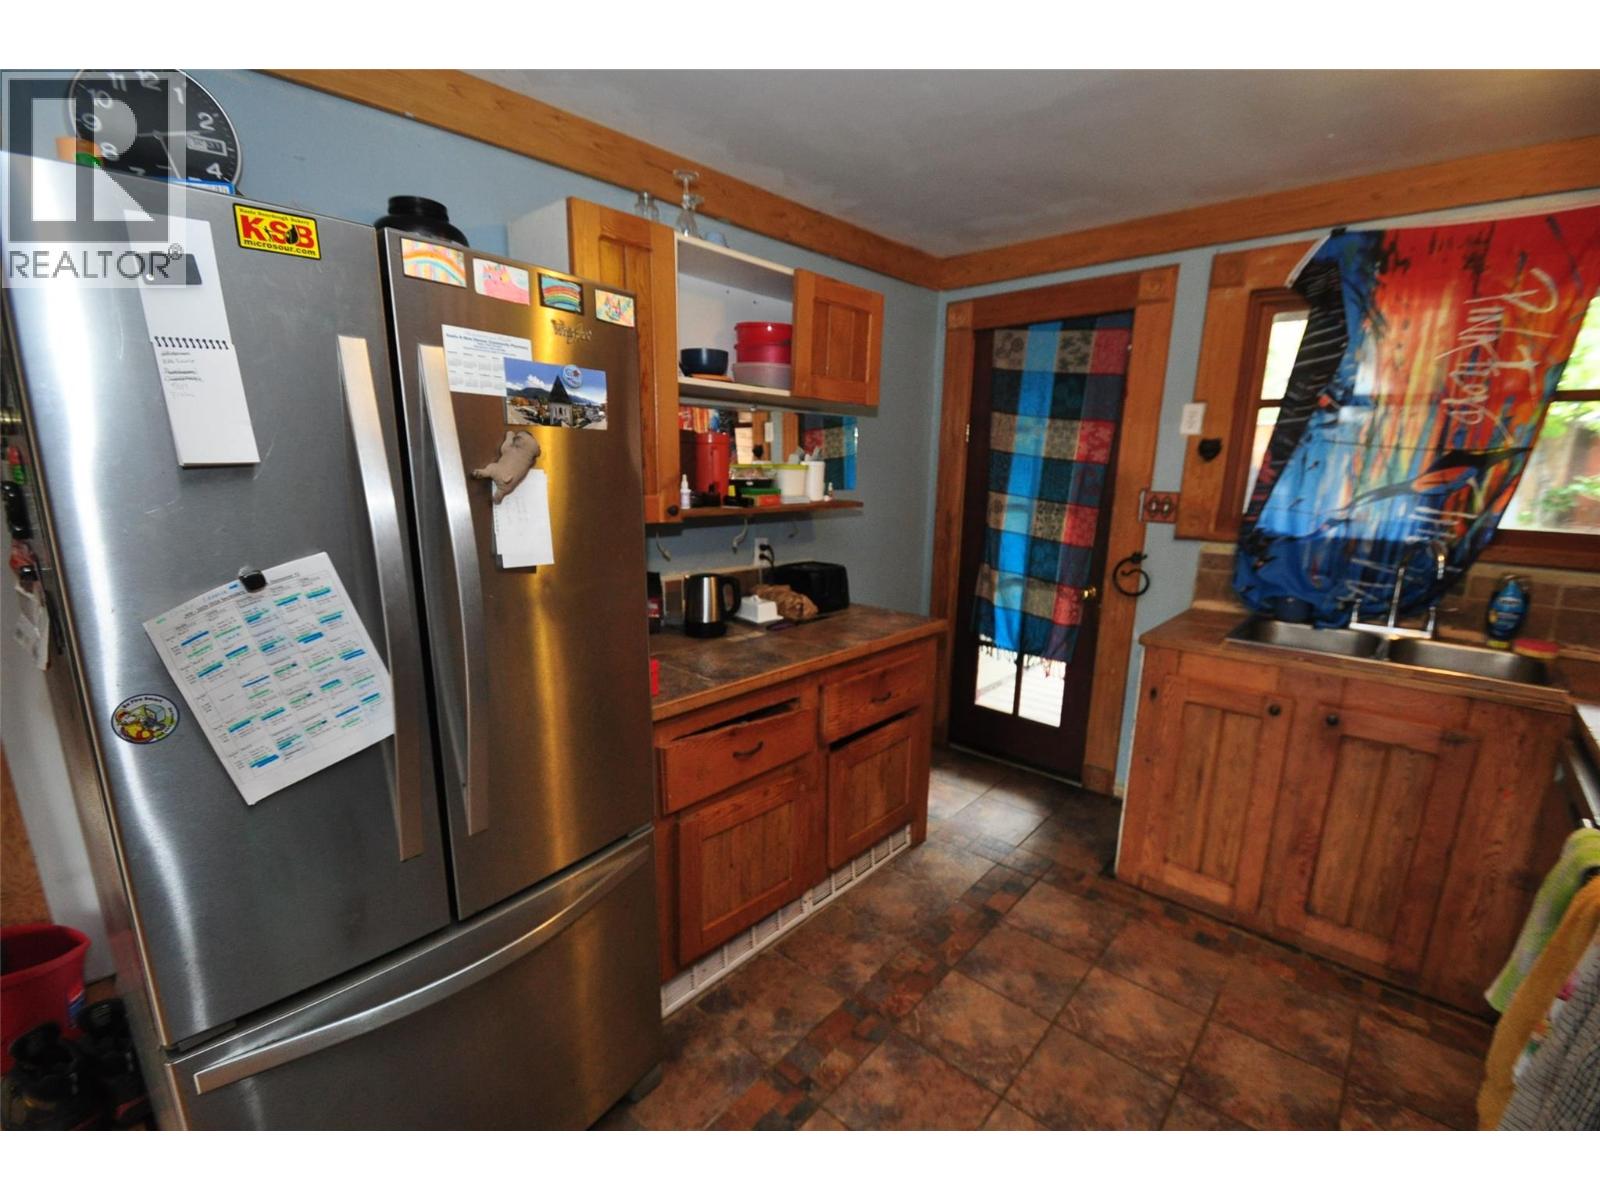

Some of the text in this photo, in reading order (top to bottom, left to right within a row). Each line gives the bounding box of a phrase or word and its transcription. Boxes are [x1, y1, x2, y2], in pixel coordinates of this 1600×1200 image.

[88, 89, 113, 109] 10
[81, 112, 103, 133] 9
[198, 111, 215, 131] 2
[100, 142, 120, 162] 8
[206, 162, 224, 180] 4
[240, 215, 314, 249] KSB
[243, 239, 316, 256] microsour.com
[1434, 267, 1560, 376] PINK
